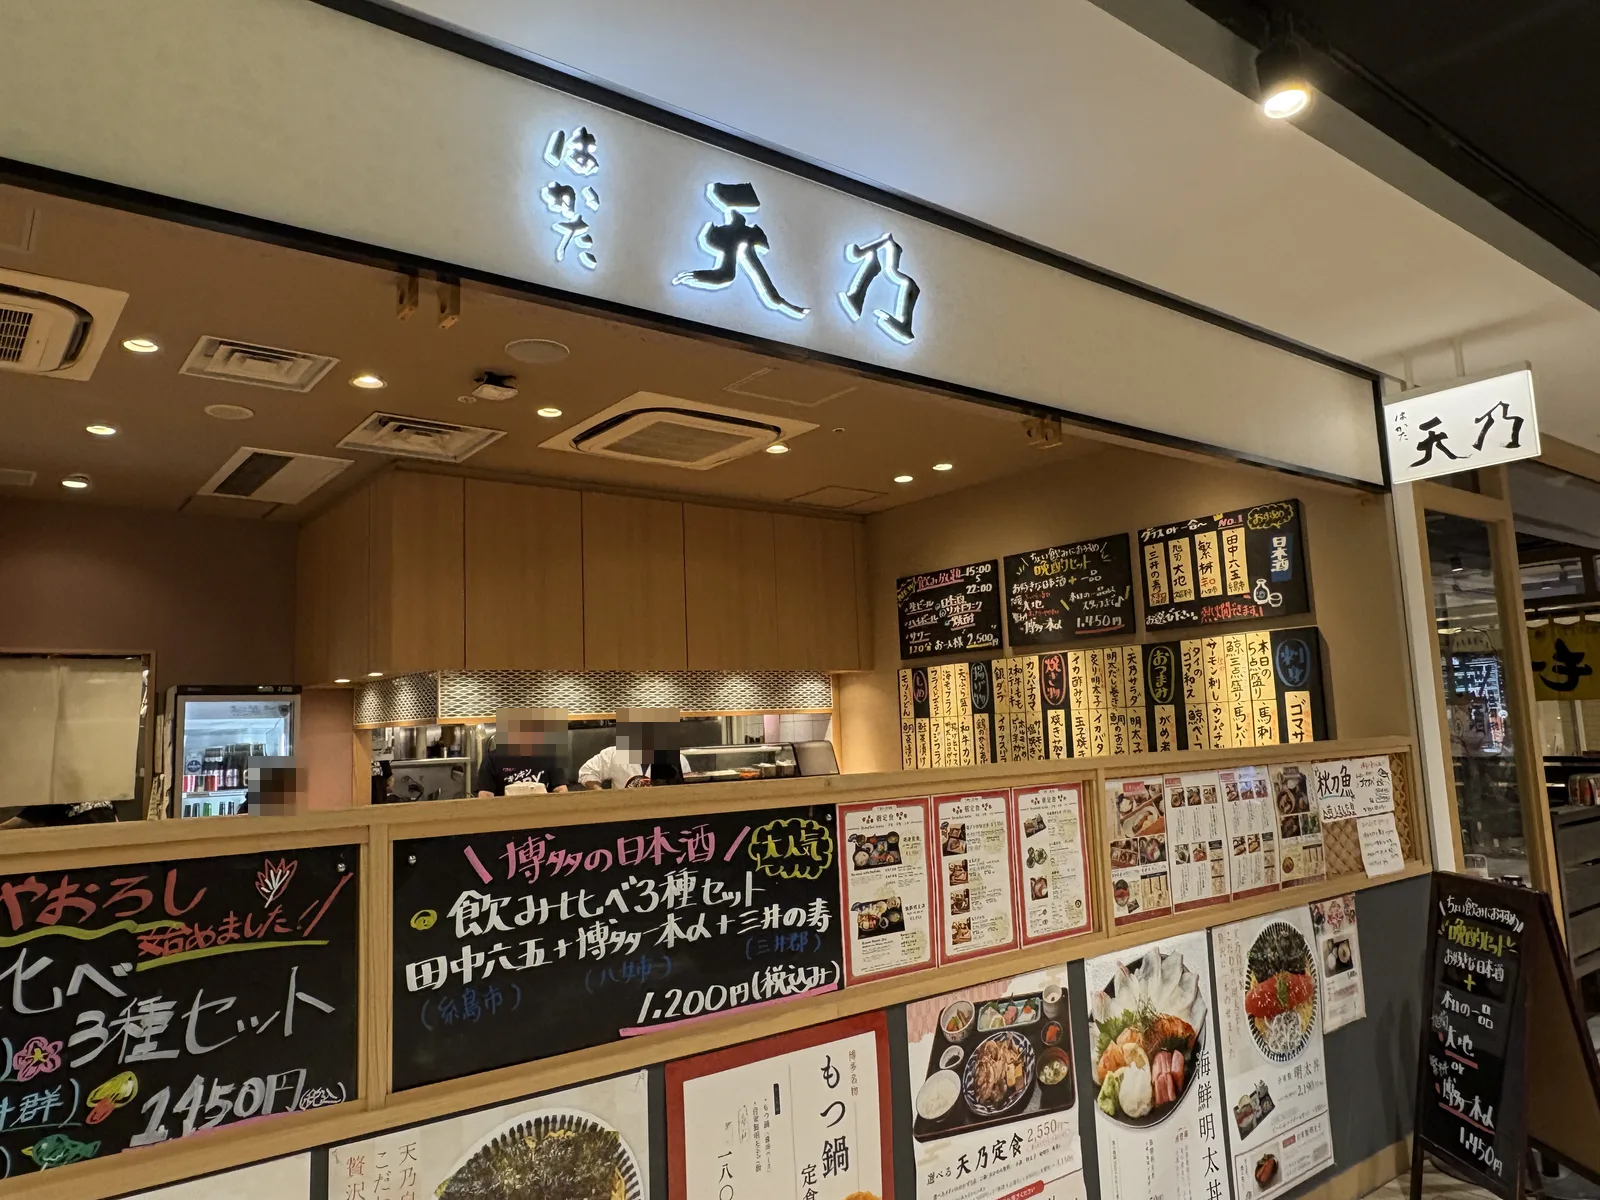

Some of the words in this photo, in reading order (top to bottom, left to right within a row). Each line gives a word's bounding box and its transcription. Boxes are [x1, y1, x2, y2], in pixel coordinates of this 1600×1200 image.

[541, 125, 599, 270] はかた
[672, 181, 920, 345] 天乃
[1394, 412, 1409, 441] はかた
[1406, 400, 1524, 468] 天乃
[966, 564, 991, 577] 15:00
[1173, 563, 1187, 587] 大地
[1226, 535, 1241, 581] 田中六五
[1271, 535, 1289, 572] 日本酒
[966, 583, 993, 594] 22:00
[1090, 653, 1102, 708] 炙り明太子
[1127, 653, 1141, 707] 天乃サラダ
[1153, 650, 1170, 698] おつまみ
[1206, 639, 1221, 701] サーモン刺し
[1258, 640, 1272, 680] 本日の
[1317, 764, 1353, 797] 秋刀魚
[499, 823, 715, 884] 博多の日本酒
[758, 827, 821, 868] 大人気
[446, 867, 766, 938] 飲み比べ3種セット
[1444, 948, 1505, 982] お好きな日本酒
[67, 965, 336, 1069] 3種セット
[1451, 1061, 1465, 1075] or
[820, 1054, 850, 1178] もつ鍋
[1195, 1050, 1224, 1200] 海鮮明太丼
[373, 1151, 392, 1200] こだ
[955, 1132, 1024, 1180] 天乃定食
